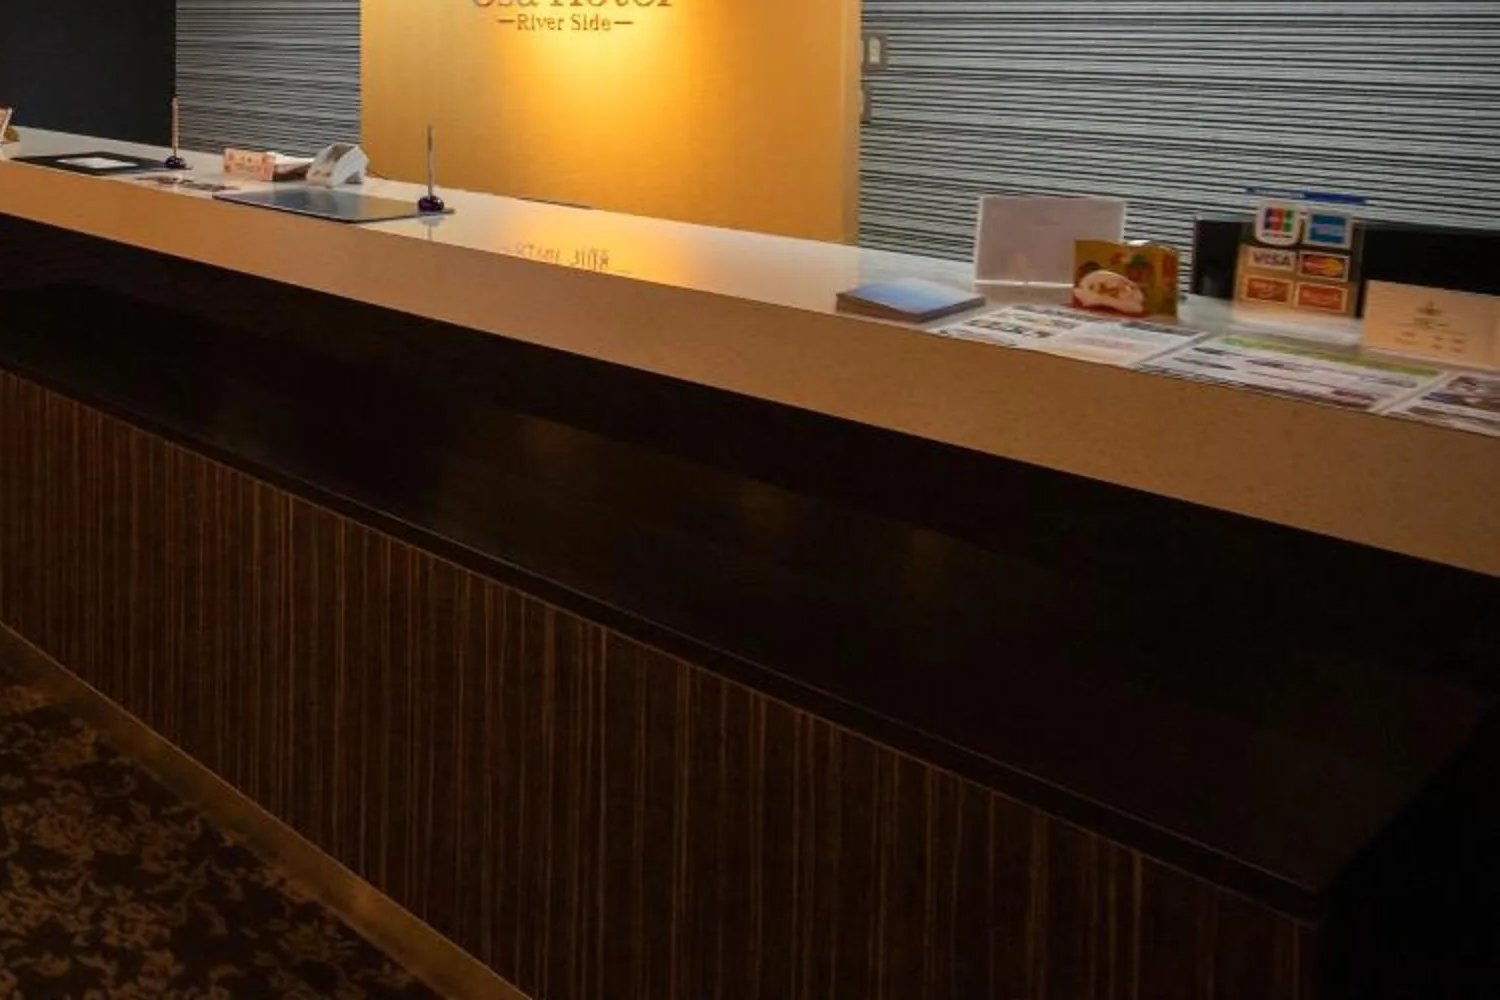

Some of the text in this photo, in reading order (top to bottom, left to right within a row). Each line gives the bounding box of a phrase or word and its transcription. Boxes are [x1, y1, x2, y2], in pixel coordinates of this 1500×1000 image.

[517, 13, 612, 32] River Side
[1253, 251, 1292, 266] VISA
